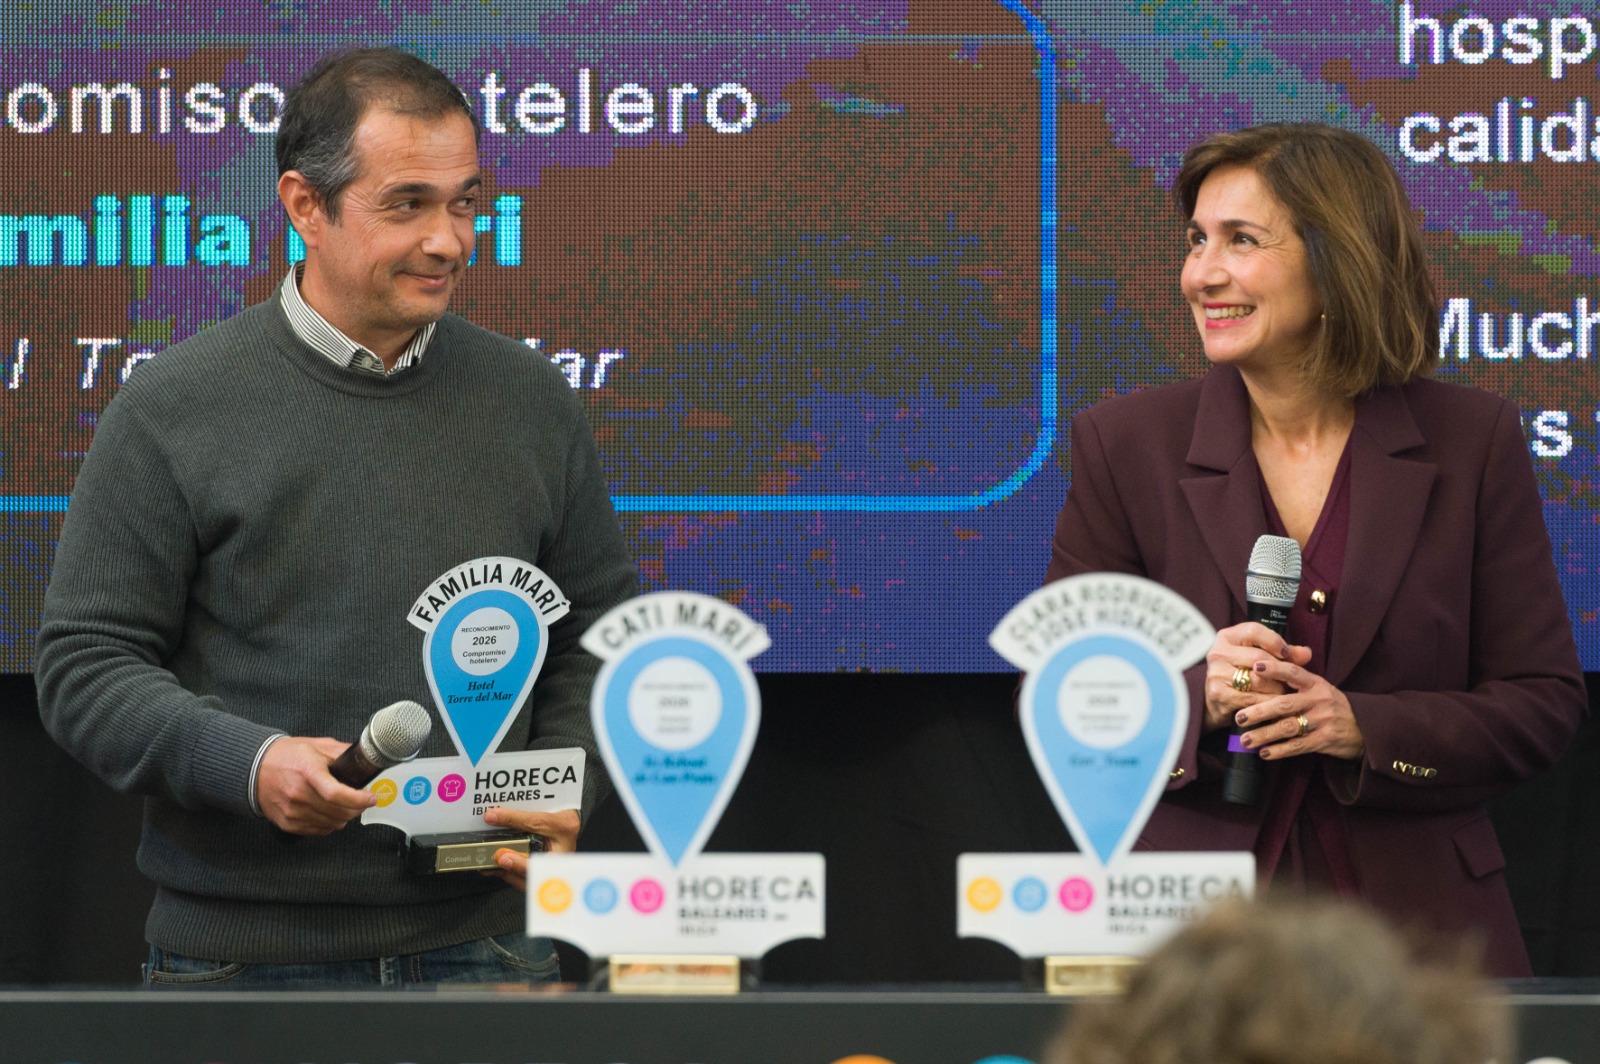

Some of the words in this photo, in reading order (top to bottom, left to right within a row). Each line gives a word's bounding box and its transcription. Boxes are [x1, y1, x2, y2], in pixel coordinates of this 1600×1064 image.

[1400, 0, 1597, 79] hosp
[7, 67, 285, 133] omiso
[1400, 97, 1600, 162] calid
[521, 338, 625, 388] ar
[416, 563, 503, 623] FAMILIA
[509, 566, 567, 616] MARÍ
[461, 625, 511, 633] RECONOCIMIENTO
[601, 603, 665, 650] CATI
[472, 635, 497, 646] 2026
[462, 649, 507, 658] Compromiso
[469, 657, 498, 665] hotelero
[447, 694, 474, 704] Torre
[475, 691, 490, 702] del
[491, 691, 513, 701] Mar
[467, 680, 495, 691] Hotel
[474, 765, 577, 790] HORECA
[473, 789, 541, 805] BALEARES
[677, 875, 815, 901] HORECA
